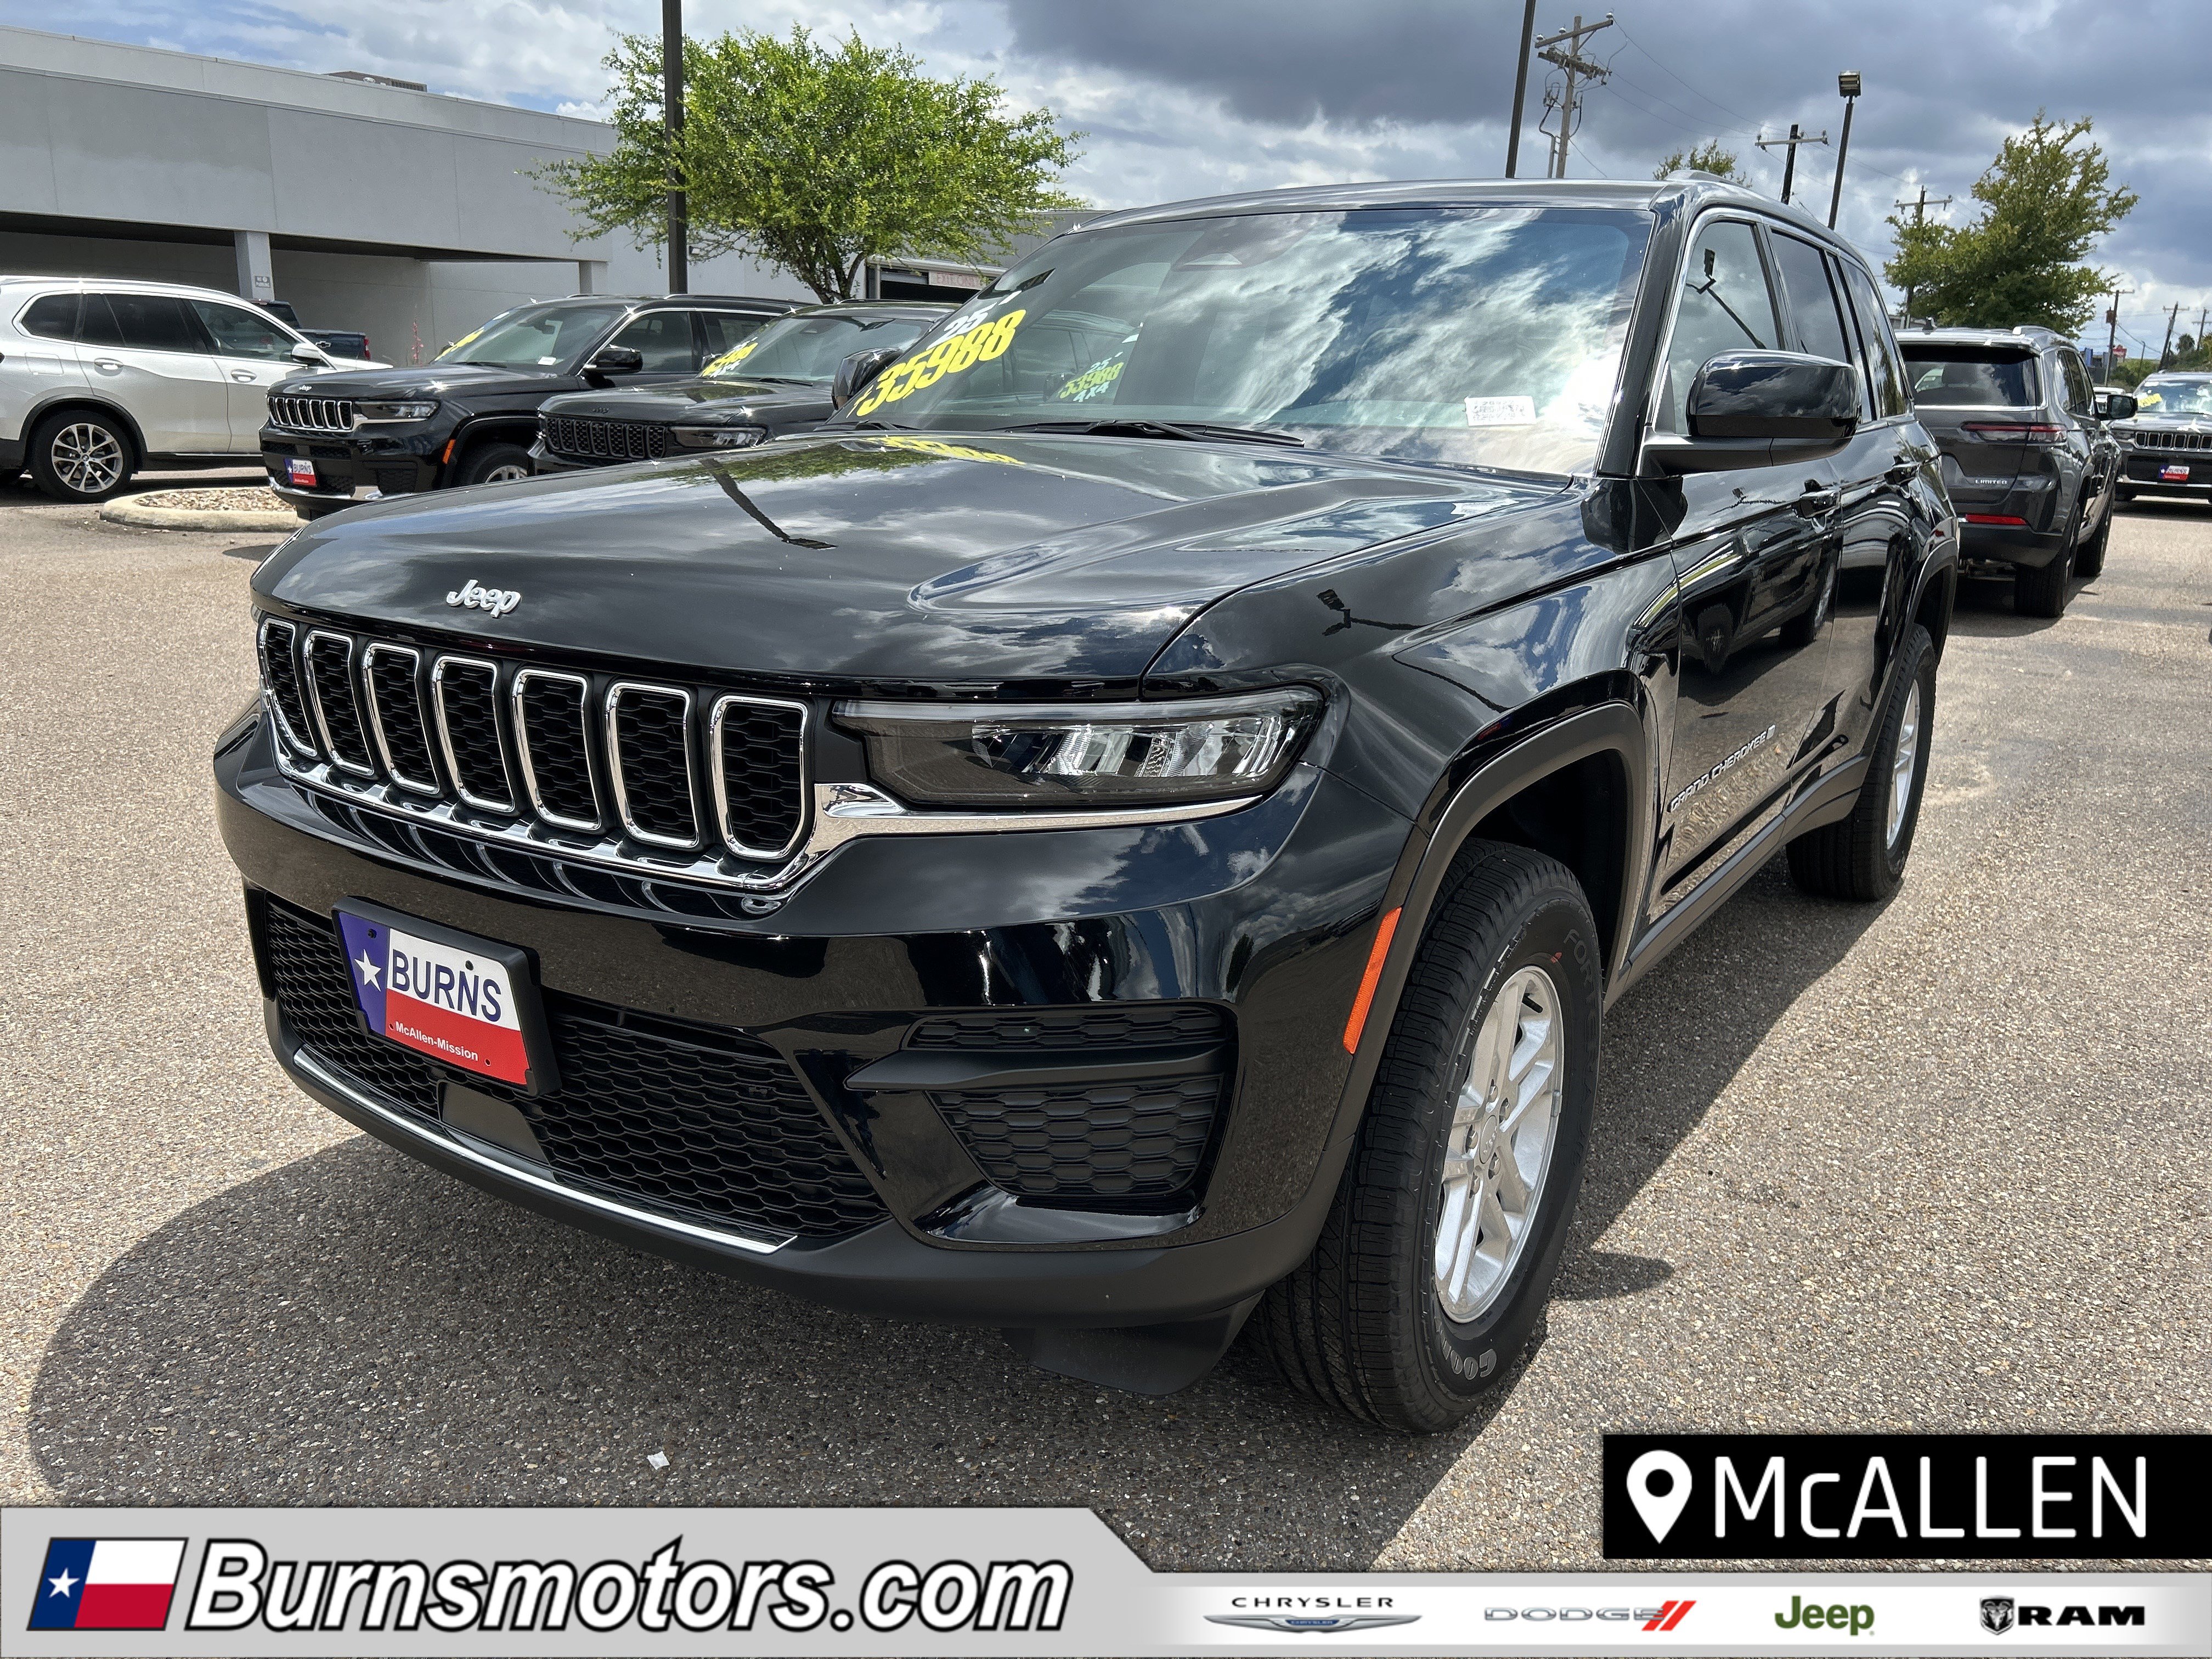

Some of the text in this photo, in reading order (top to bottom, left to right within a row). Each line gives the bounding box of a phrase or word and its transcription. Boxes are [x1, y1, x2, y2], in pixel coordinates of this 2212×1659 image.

[446, 579, 522, 618] Jeep
[1710, 731, 1767, 780] CHEROKEE
[1668, 773, 1709, 813] GRAND
[392, 949, 501, 1022] BURNS
[396, 1021, 478, 1062] McAllen-Mission
